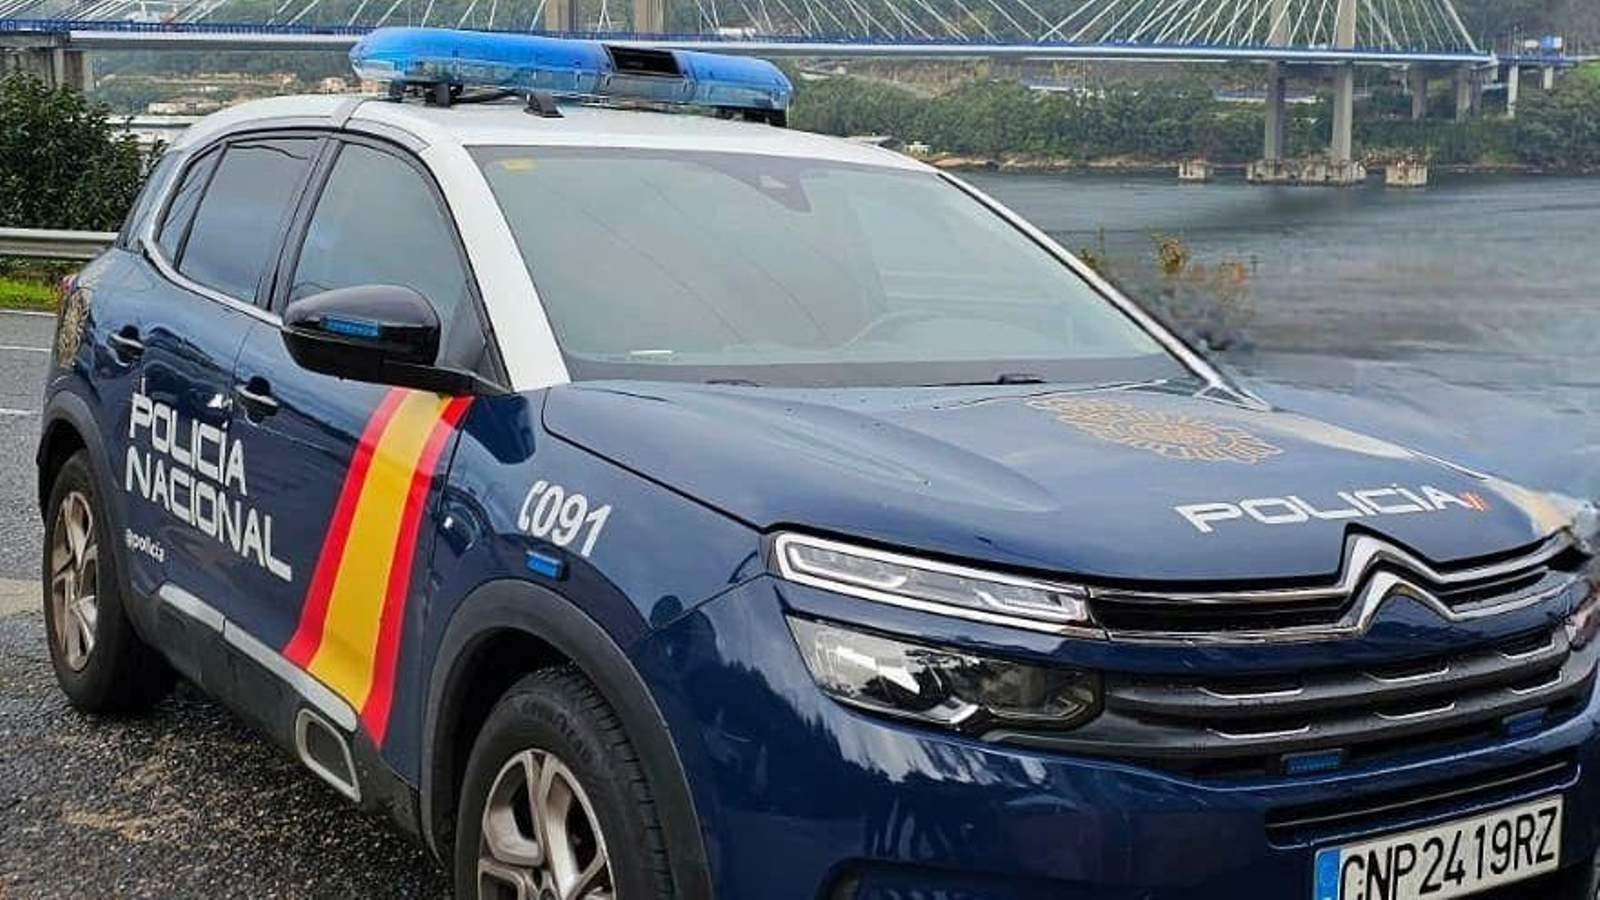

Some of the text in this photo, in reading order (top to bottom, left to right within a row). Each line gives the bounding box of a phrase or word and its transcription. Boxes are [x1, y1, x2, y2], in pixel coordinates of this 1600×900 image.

[129, 393, 247, 495] POLICÍA
[125, 446, 292, 582] NACIONAL
[531, 485, 611, 557] 091
[1174, 484, 1470, 533] POLICÍA
